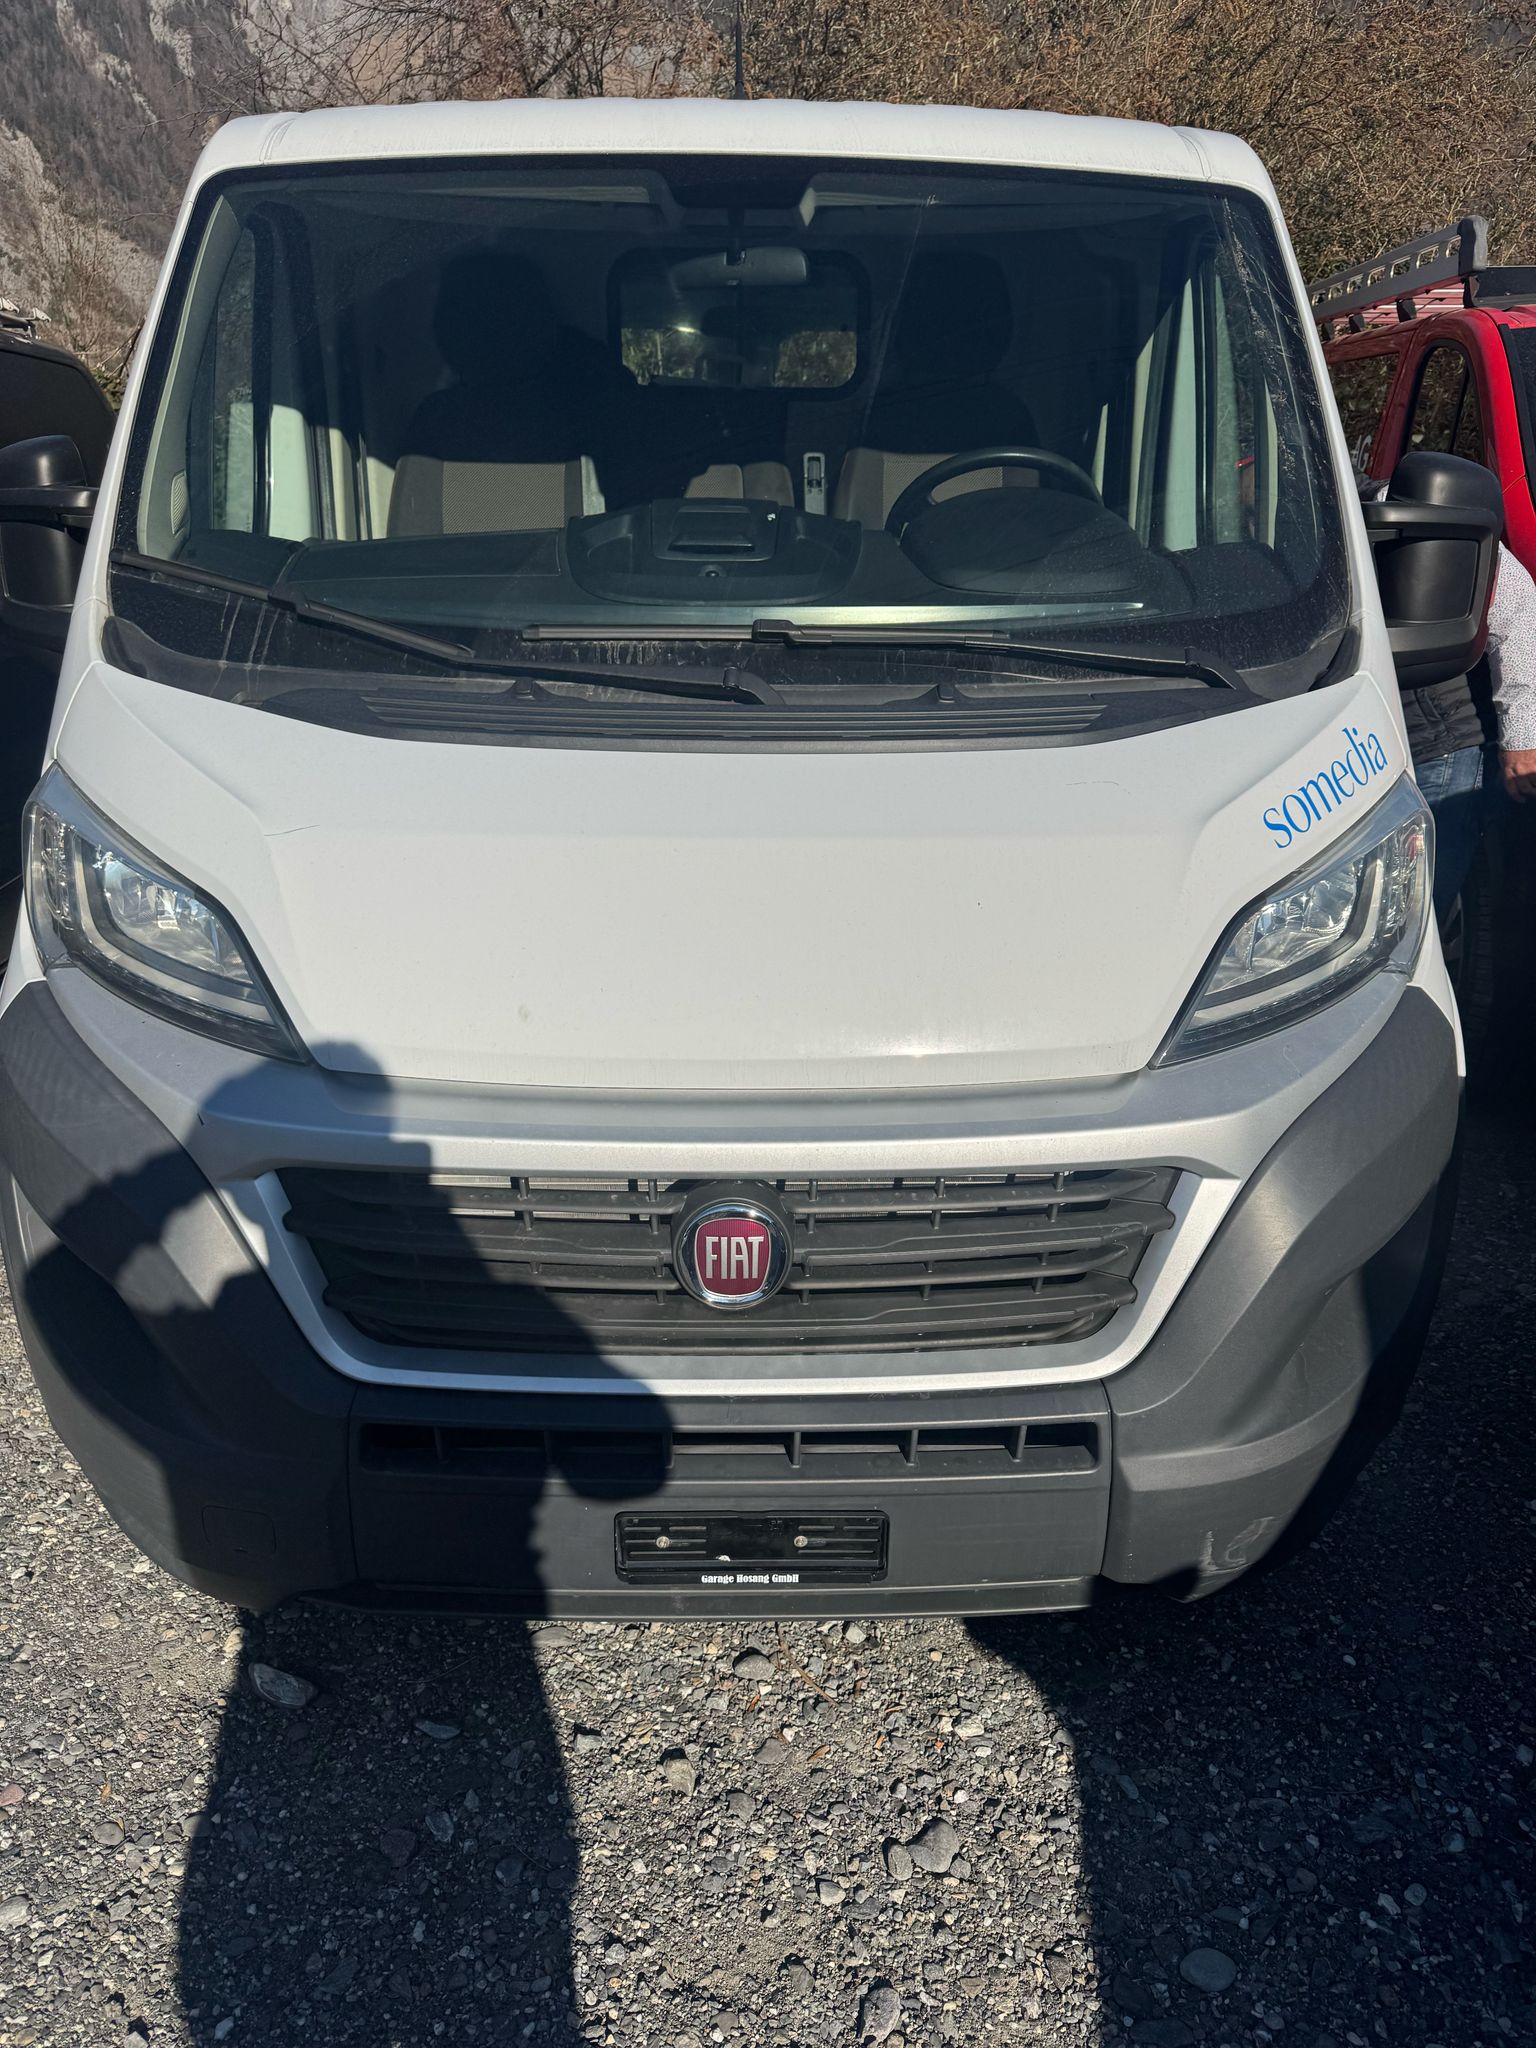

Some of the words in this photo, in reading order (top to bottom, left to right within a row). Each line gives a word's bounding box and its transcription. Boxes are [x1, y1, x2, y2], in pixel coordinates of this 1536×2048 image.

[1263, 727, 1388, 849] somedia
[705, 1236, 765, 1280] FIAT
[701, 1574, 735, 1584] Garage
[736, 1573, 770, 1584] Hosang
[771, 1573, 800, 1583] GmbH
